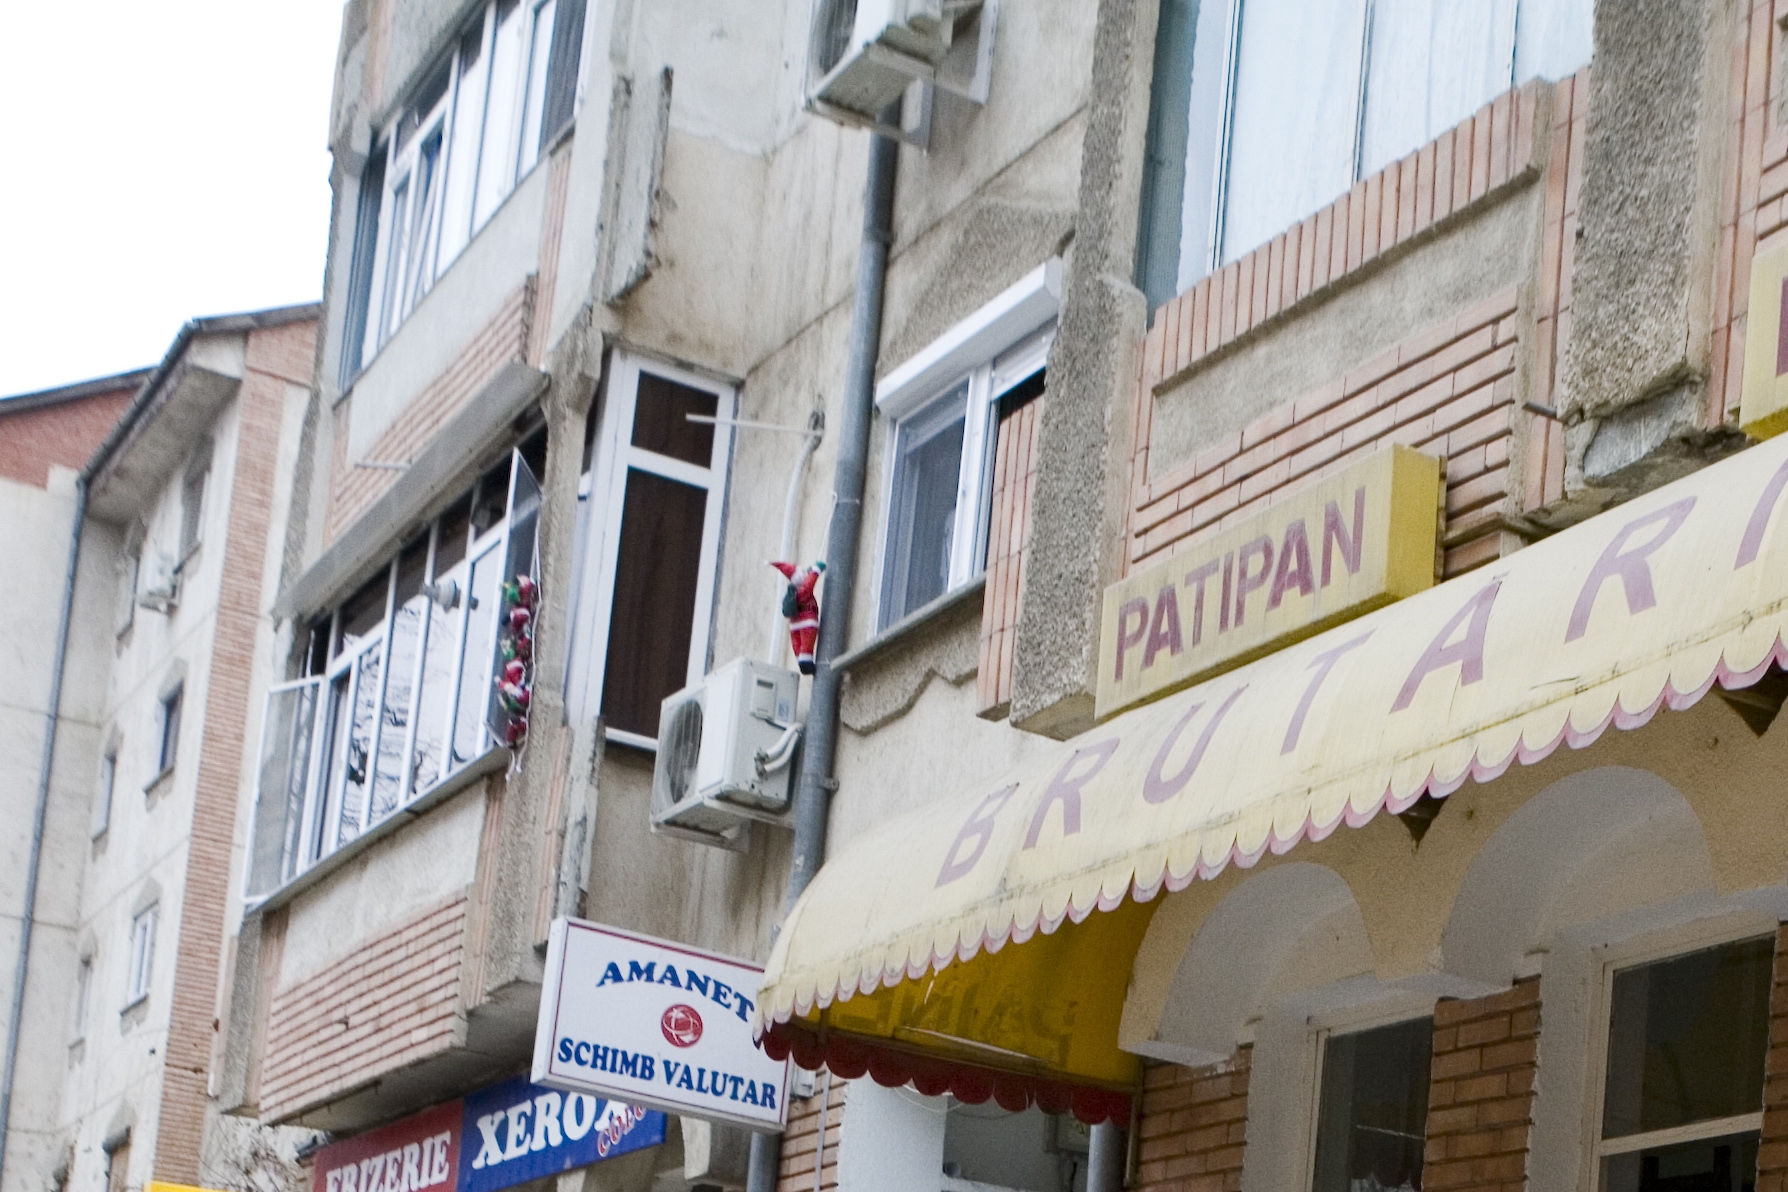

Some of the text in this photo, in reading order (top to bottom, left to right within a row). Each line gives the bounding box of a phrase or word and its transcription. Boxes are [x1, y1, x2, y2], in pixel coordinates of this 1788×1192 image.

[1114, 486, 1366, 684] PATIPAN
[596, 960, 755, 1023] AMANET
[557, 1037, 777, 1110] SCHIMB VALUTAR
